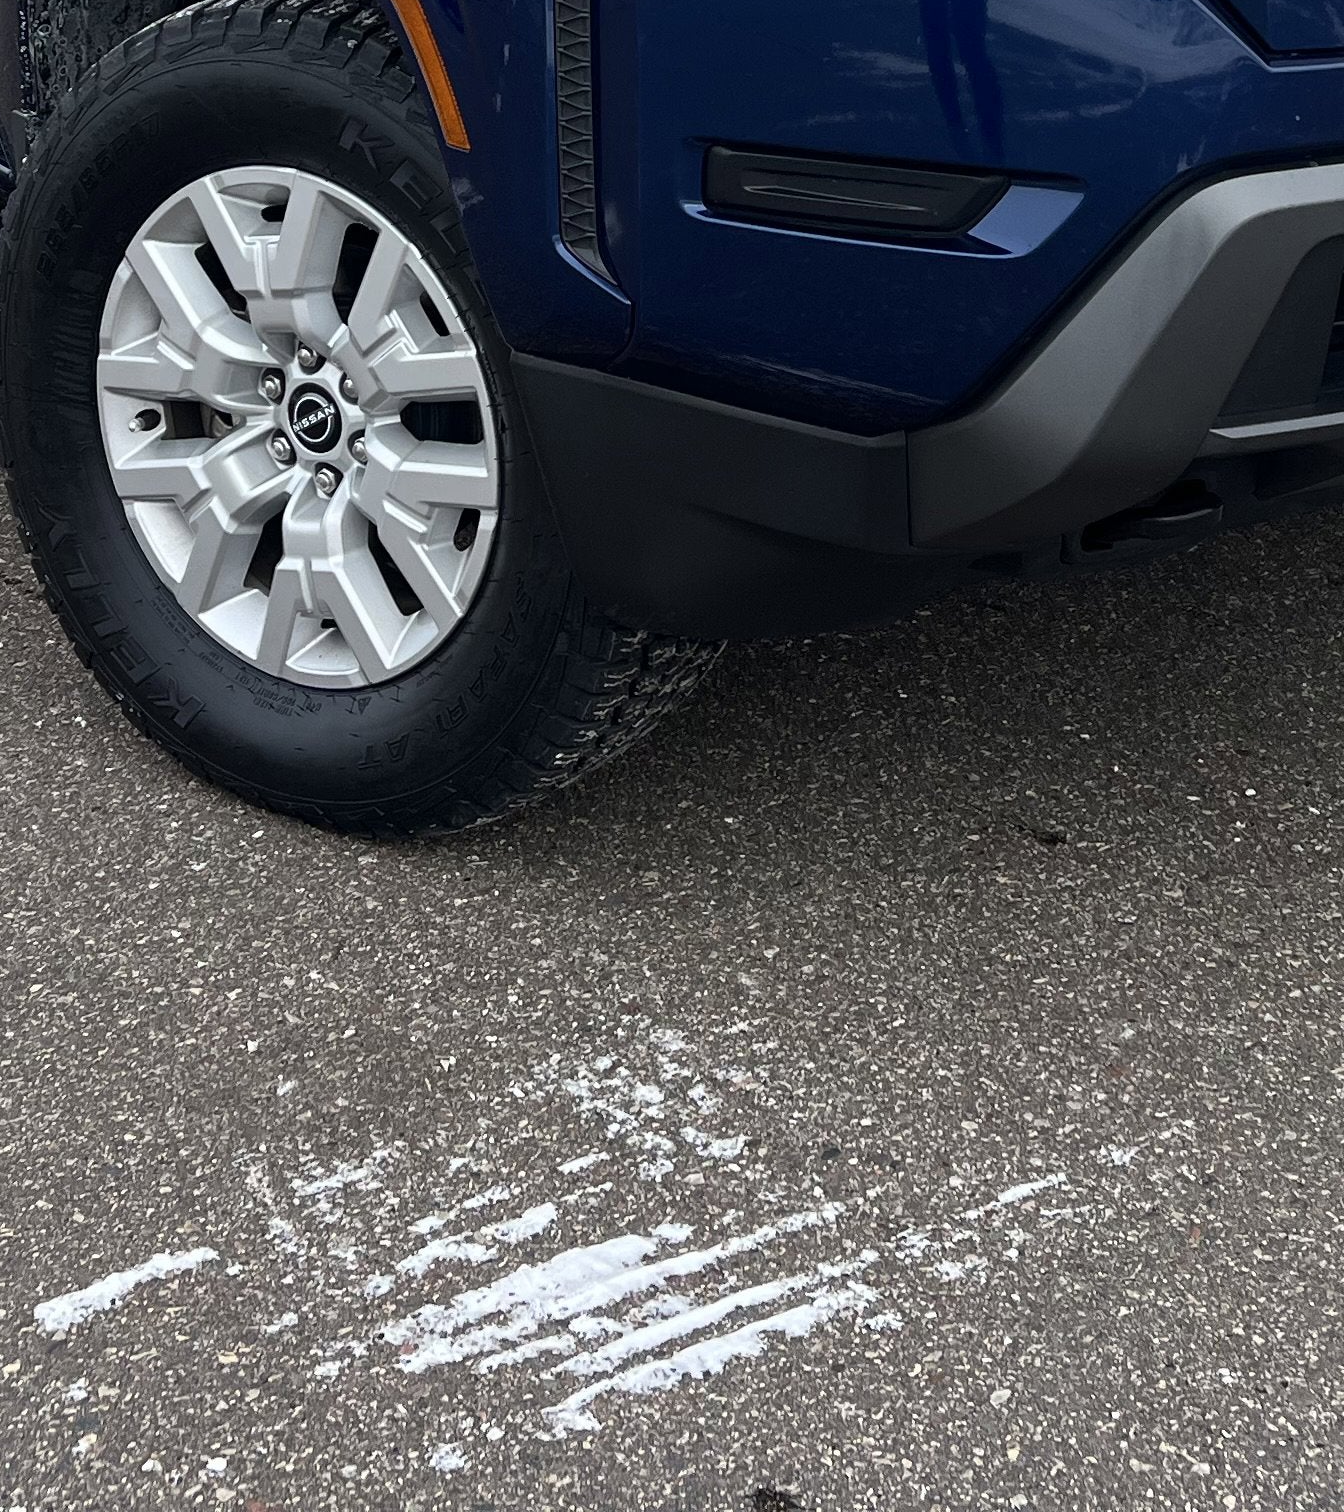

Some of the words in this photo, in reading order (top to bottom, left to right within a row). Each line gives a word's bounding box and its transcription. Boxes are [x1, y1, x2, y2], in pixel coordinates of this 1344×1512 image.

[292, 404, 336, 433] NISSAN
[32, 496, 206, 729] KELLY
[357, 733, 409, 770] AT
